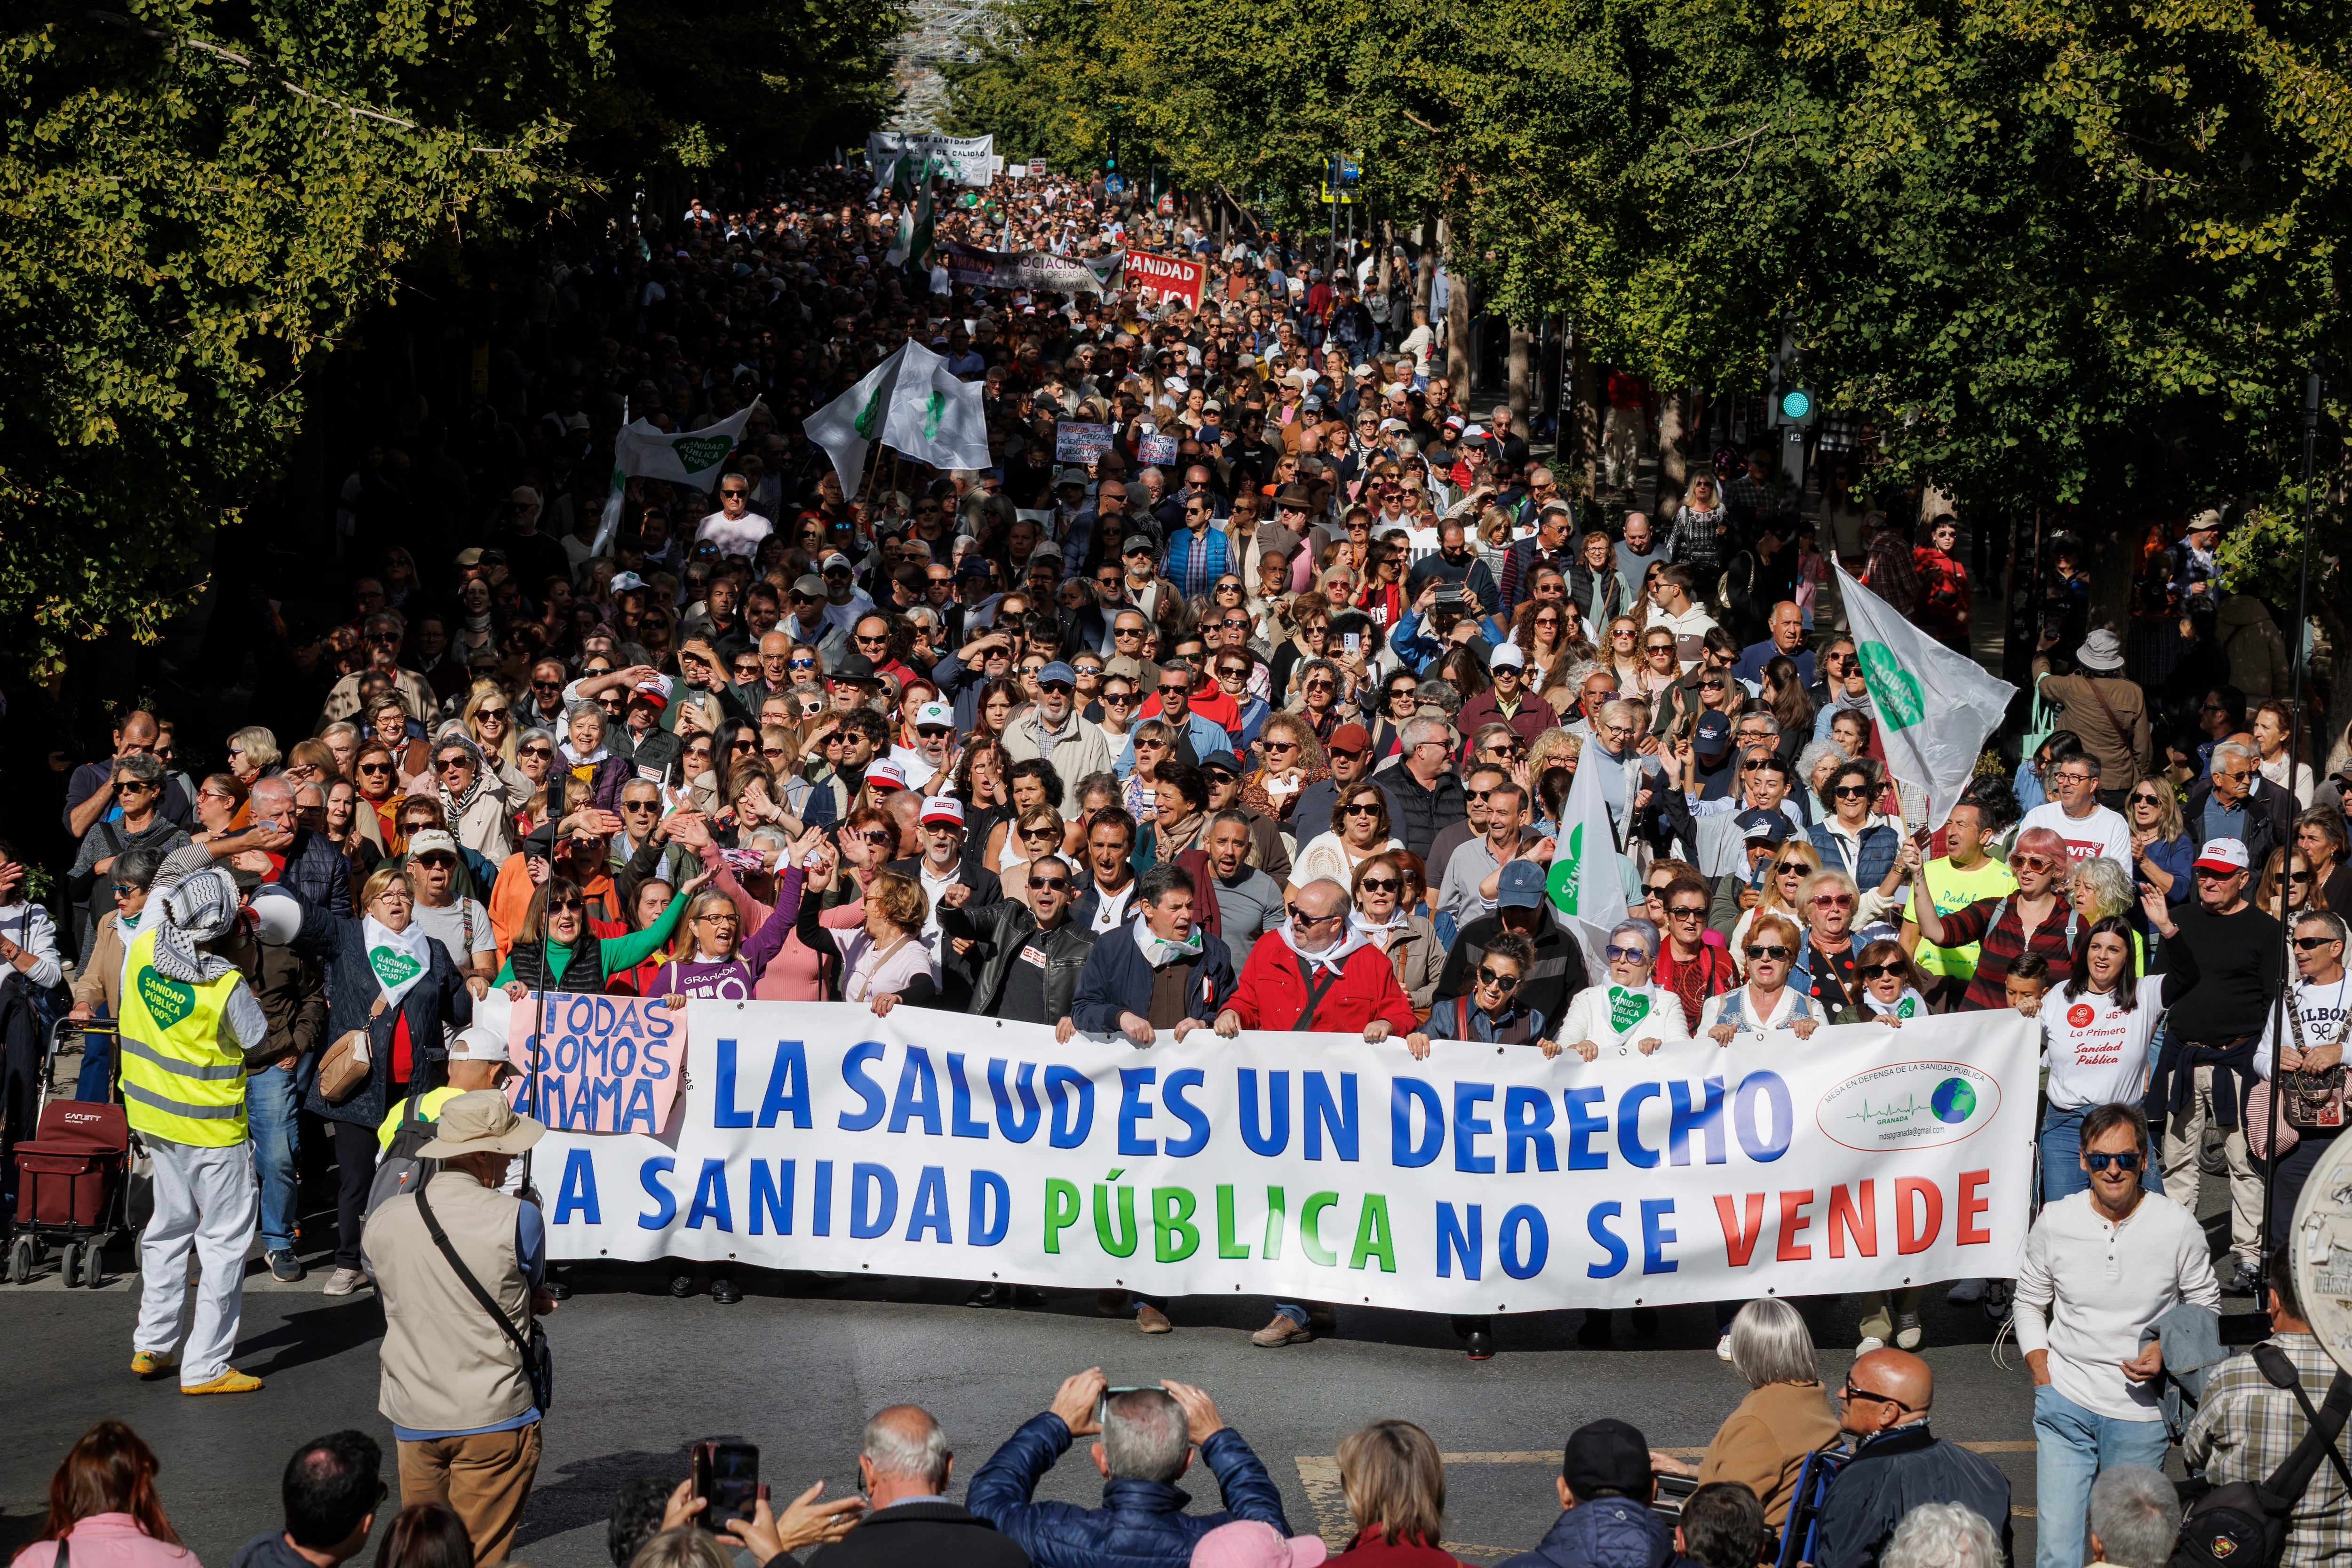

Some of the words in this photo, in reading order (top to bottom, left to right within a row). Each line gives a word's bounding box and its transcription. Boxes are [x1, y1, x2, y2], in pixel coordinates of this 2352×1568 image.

[1009, 268, 1044, 278] MUJERES
[1125, 255, 1194, 281] SANIDAD
[1789, 433, 1801, 441] 12
[882, 767, 899, 777] CCOO
[2208, 847, 2226, 856] CCOO
[683, 967, 737, 984] GRANADA
[145, 977, 186, 1004] SANIDAD
[699, 987, 713, 997] UN
[145, 989, 180, 1016] PÚBLICA
[1611, 995, 1642, 1009] SANIDAD
[150, 1005, 172, 1023] 100%
[531, 992, 674, 1039] TODAS
[1613, 1014, 1633, 1025] 100%
[2070, 1016, 2088, 1025] UGT
[2086, 1027, 2126, 1036] Primero
[2074, 1041, 2123, 1054] Sanidad
[524, 1035, 670, 1080] SOMOS
[2075, 1054, 2119, 1066] Pública
[1825, 1086, 1845, 1103] MESA
[1846, 1079, 1857, 1090] EN
[1858, 1069, 1895, 1084] DEFENSA
[1920, 1063, 1952, 1072] SANIDAD
[1954, 1066, 1985, 1082] PÚBLICA
[512, 1073, 656, 1134] AMAMA
[714, 1037, 813, 1130] LA
[837, 1040, 1094, 1149] SALUD
[1118, 1065, 1211, 1158] ES
[1238, 1067, 1360, 1162] UN
[1391, 1069, 1794, 1174] DERECHO
[1876, 1115, 1909, 1125] GRANADA
[1878, 1126, 1945, 1141] mdspgranada@gmail.com
[637, 1155, 1010, 1247] SANIDAD
[1043, 1168, 1398, 1273] PÚBLICA
[1436, 1199, 1549, 1281] NO
[1586, 1197, 1679, 1279] SE
[1713, 1168, 1991, 1267] VENDE
